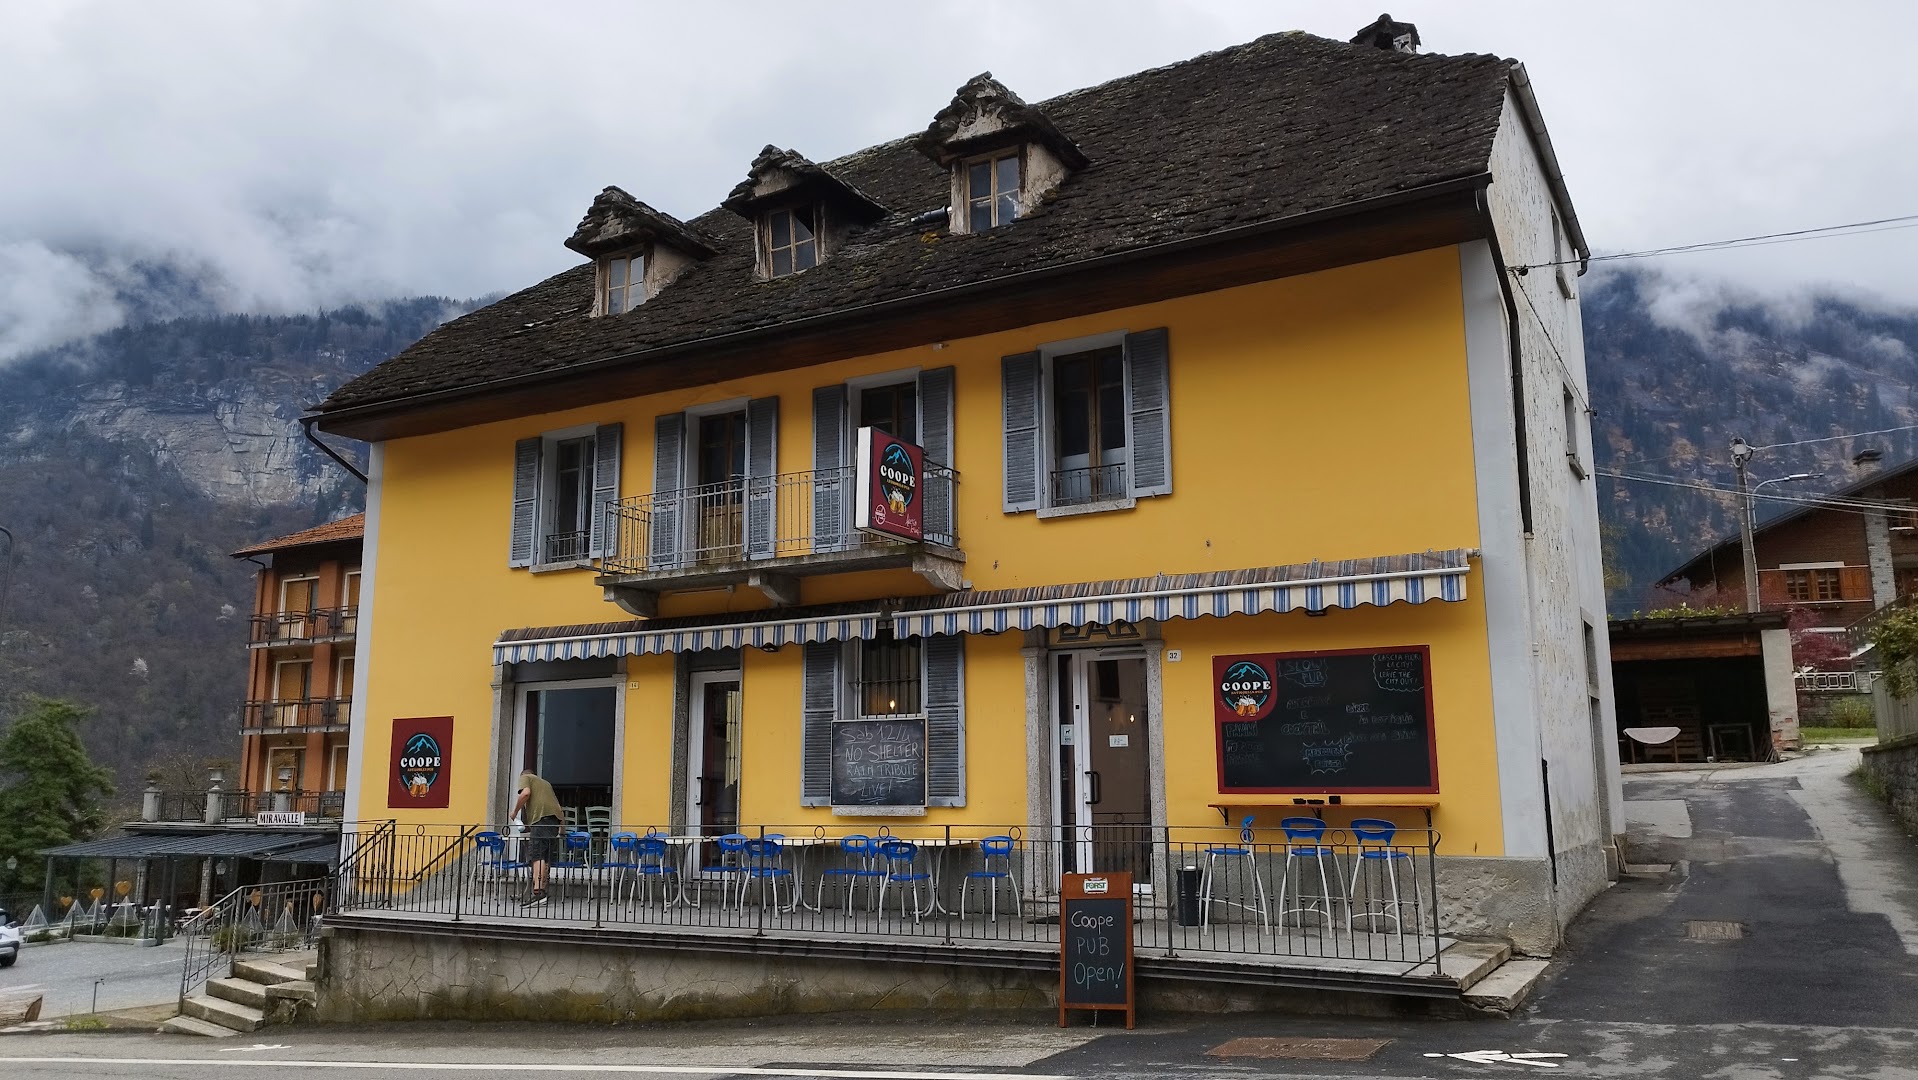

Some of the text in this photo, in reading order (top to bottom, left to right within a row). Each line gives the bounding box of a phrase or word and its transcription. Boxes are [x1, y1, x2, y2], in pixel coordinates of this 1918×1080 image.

[880, 464, 916, 487] COOPE
[1286, 660, 1322, 672] SLOW
[1302, 671, 1324, 683] PUB
[1221, 681, 1271, 691] COOPE
[846, 745, 863, 761] NO
[401, 757, 441, 768] COOPE
[877, 761, 919, 776] TRIBUTE
[258, 814, 299, 824] MIRAVALLE
[1071, 911, 1114, 935] Coope
[1076, 936, 1110, 956] PUB
[1074, 962, 1125, 990] Open!
